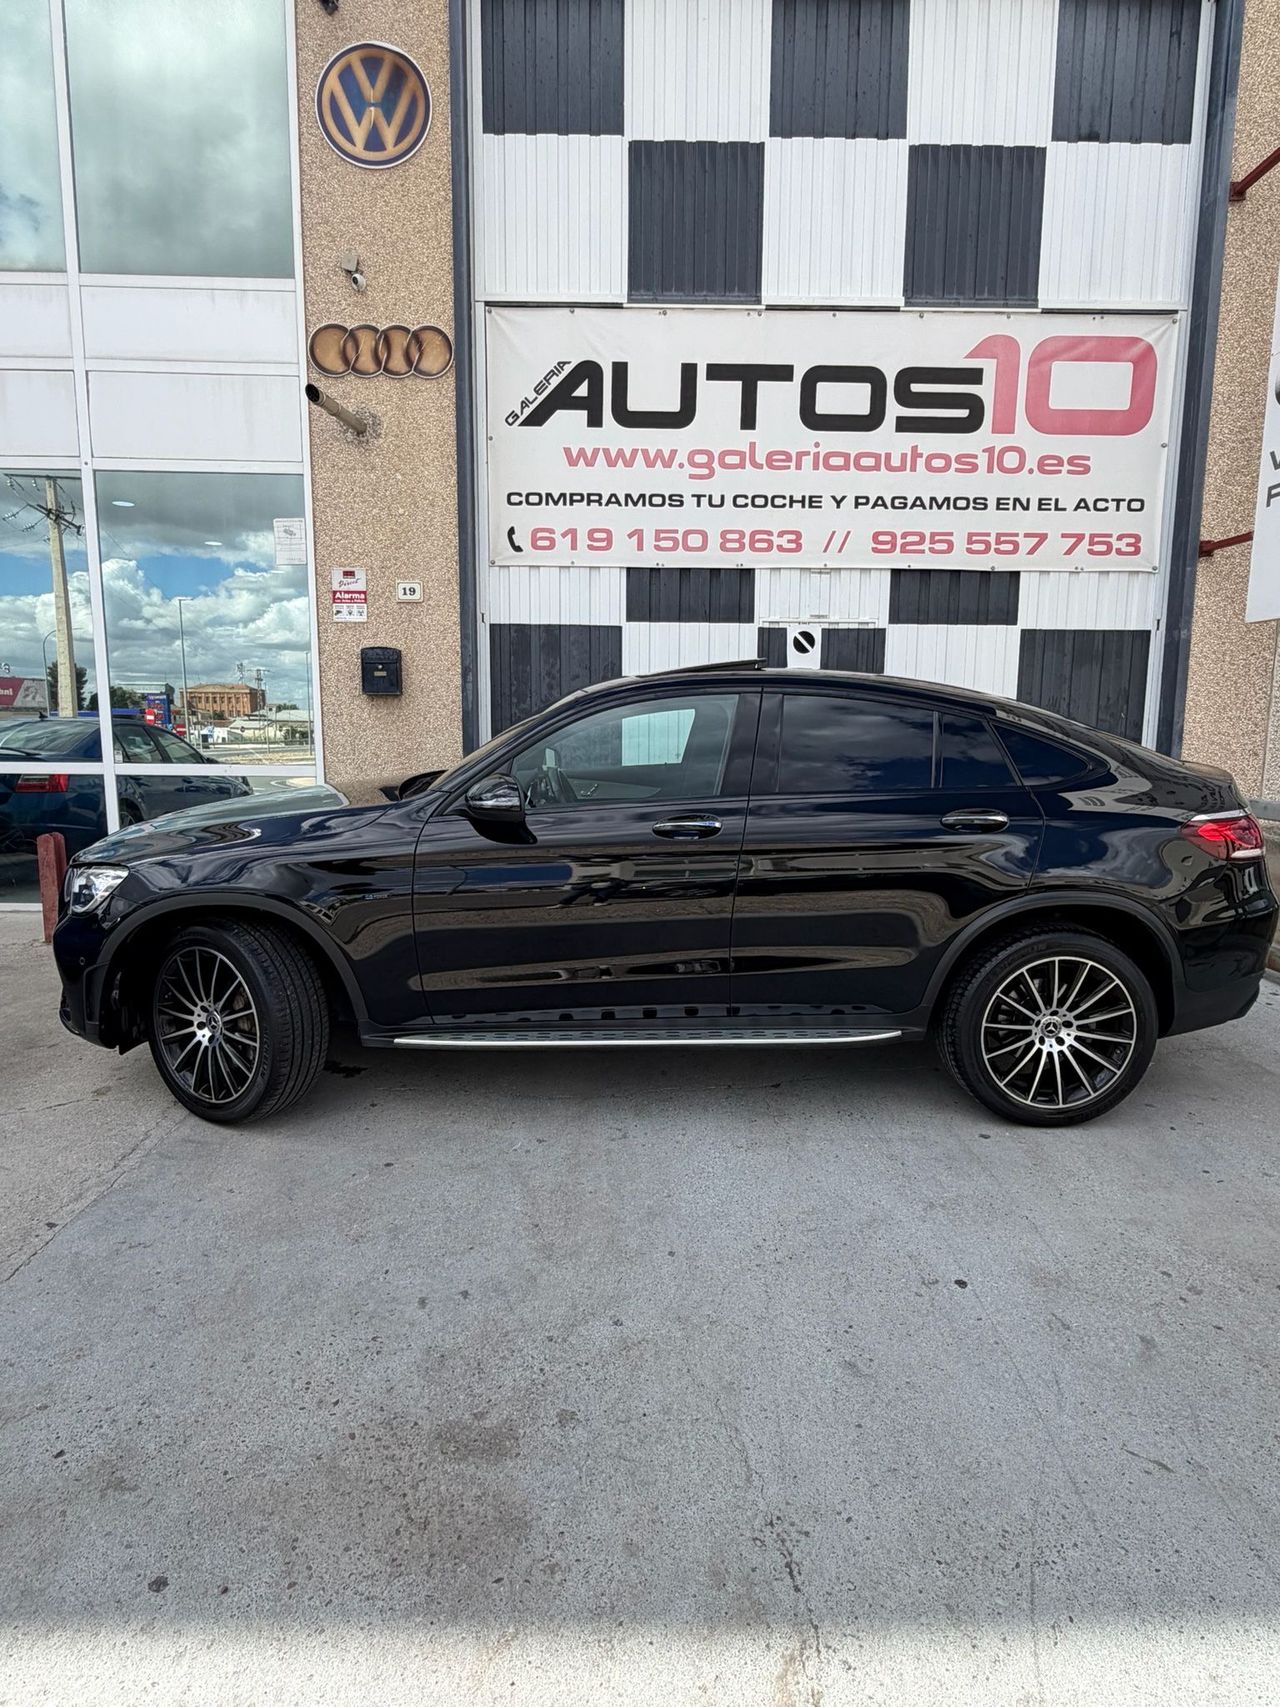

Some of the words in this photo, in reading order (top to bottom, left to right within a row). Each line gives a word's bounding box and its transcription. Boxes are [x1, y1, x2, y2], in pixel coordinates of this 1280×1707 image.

[504, 360, 572, 426] GALERIA
[563, 441, 1091, 480] www.galeriaautos10.es
[506, 492, 684, 508] COMPRAMOS
[691, 494, 725, 508] TU
[732, 495, 823, 509] COCHE
[830, 495, 847, 509] Y
[854, 496, 988, 511] PAGAMOS
[995, 497, 1030, 511] EN
[1037, 498, 1067, 511] EL
[1073, 498, 1145, 512] ACTO
[530, 528, 613, 551] 619
[627, 529, 708, 552] 150
[719, 530, 803, 553] 863
[871, 531, 954, 554] 925
[965, 532, 1048, 555] 557
[1060, 533, 1142, 556] 753
[335, 591, 365, 599] Alarma
[402, 586, 416, 596] 19
